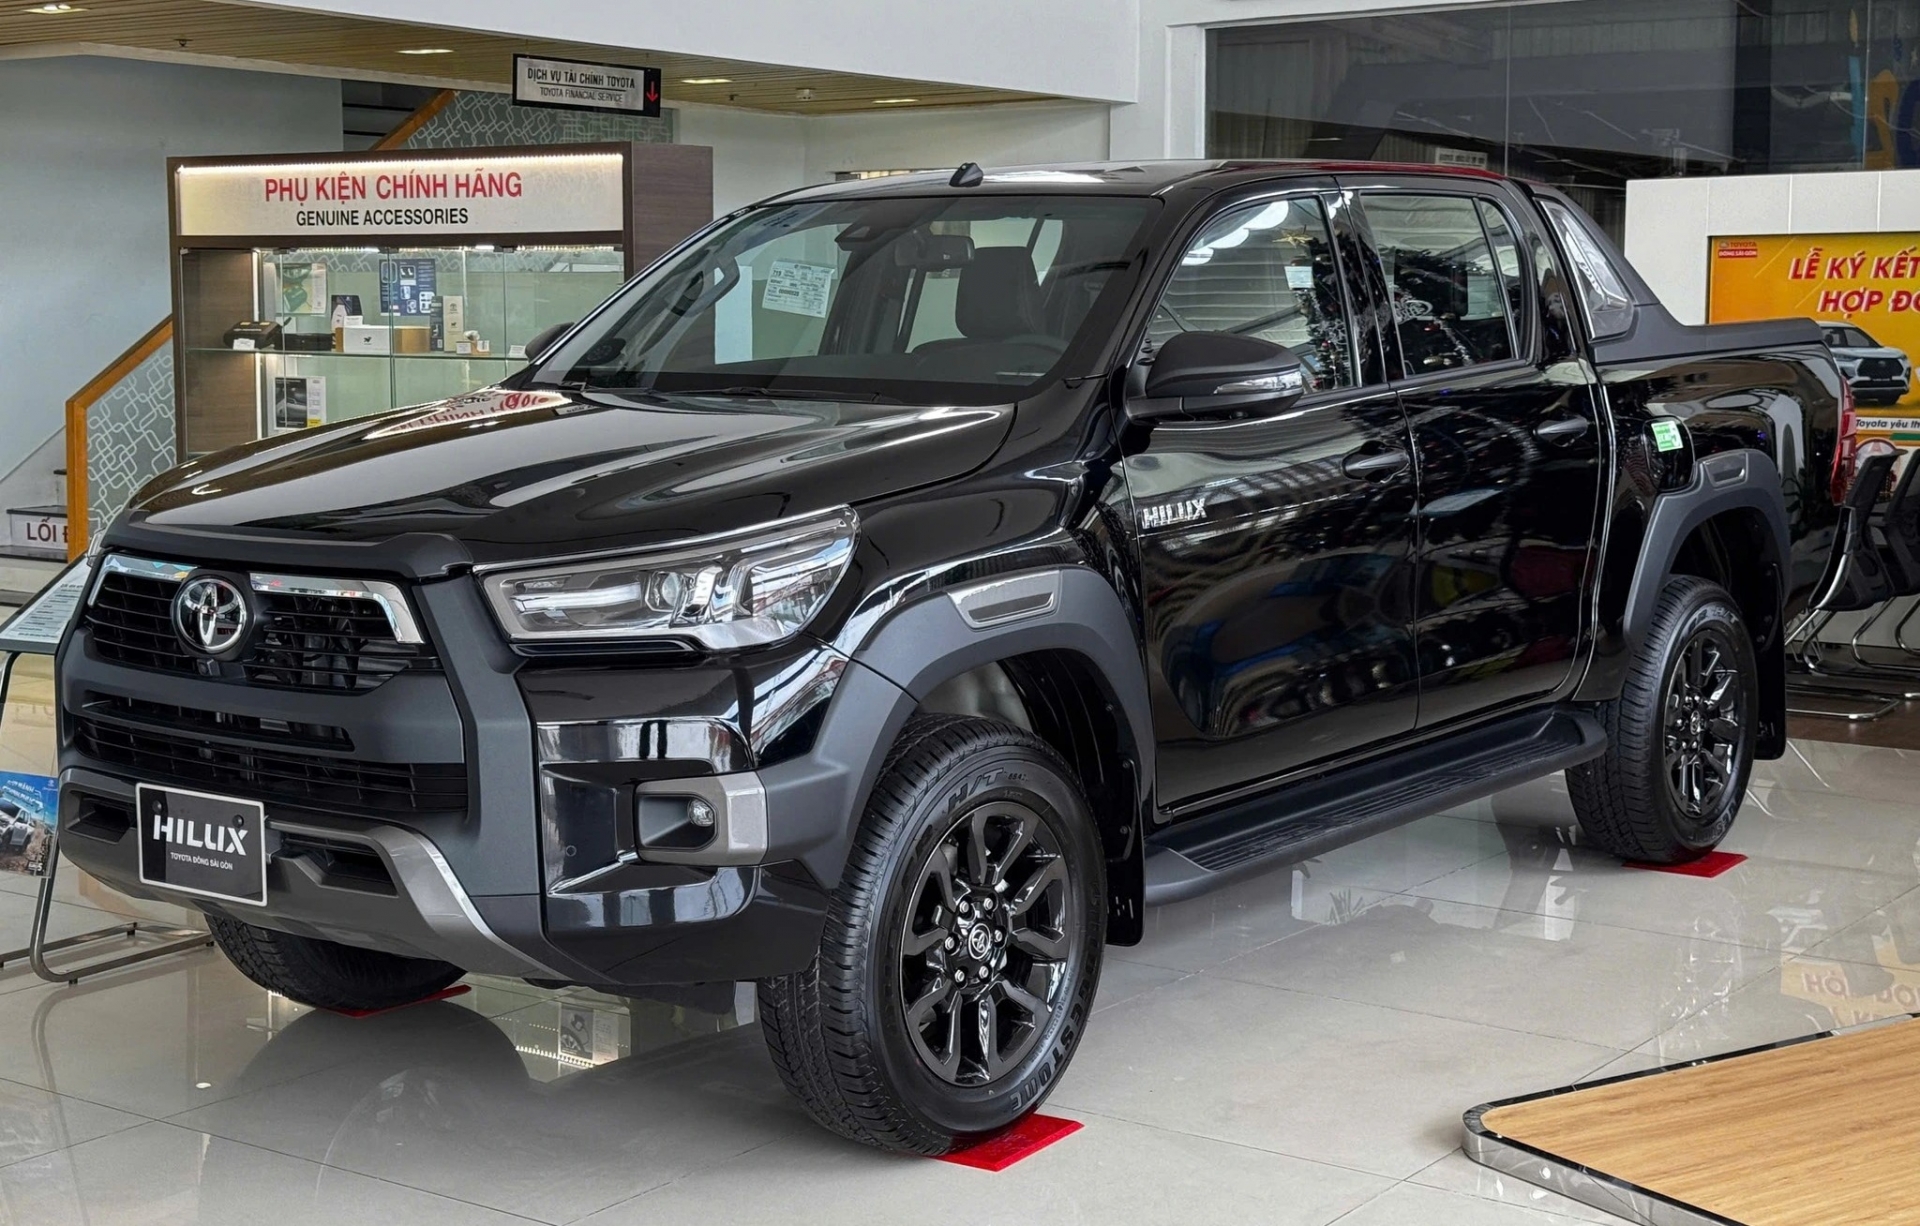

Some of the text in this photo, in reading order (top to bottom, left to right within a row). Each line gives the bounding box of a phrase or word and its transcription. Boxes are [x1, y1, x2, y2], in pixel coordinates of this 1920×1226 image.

[528, 67, 635, 88] DỊCH VỤ TÀI CHÍNH TOYOTA
[540, 86, 623, 102] TOYOTA FINANCIAL SERVICE
[265, 167, 522, 207] PHỤ KIỆN CHÍNH HÃNG
[296, 208, 468, 227] GENUINE ACCESSORIES
[1788, 245, 1920, 280] LỄ KÝ KẾT
[1817, 286, 1884, 319] HỢP
[1856, 419, 1887, 429] Toyota
[1142, 498, 1207, 529] HILUX
[26, 516, 57, 542] LỐI
[153, 814, 248, 856] HILUX
[170, 851, 192, 862] TOYOTA
